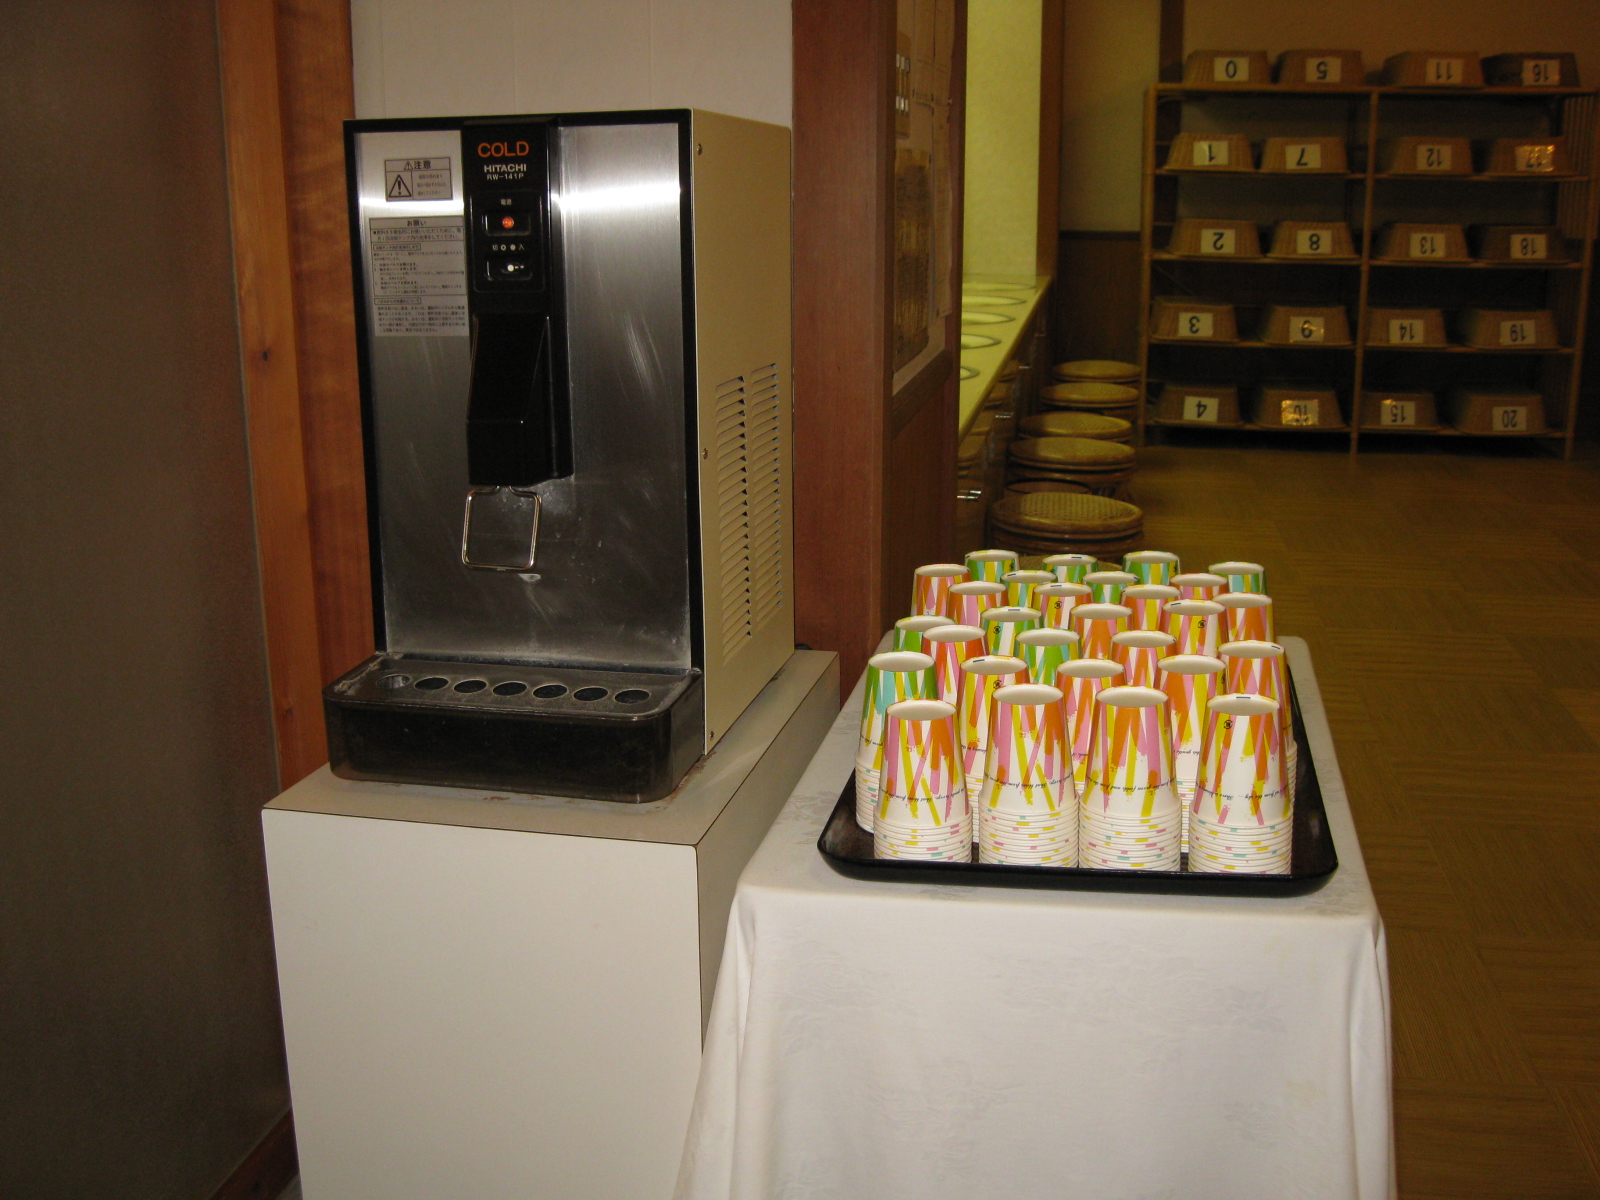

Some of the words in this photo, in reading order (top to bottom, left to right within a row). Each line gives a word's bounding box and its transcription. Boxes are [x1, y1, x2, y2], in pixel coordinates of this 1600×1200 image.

[1225, 60, 1236, 79] 0
[1317, 61, 1329, 79] 5
[1437, 63, 1453, 79] 11
[1531, 63, 1550, 81] 16
[478, 141, 530, 158] COLD
[1208, 144, 1216, 162] 1
[1296, 148, 1309, 166] 7
[1426, 148, 1443, 167] 12
[414, 160, 432, 170] 注意
[483, 163, 527, 173] HITACHI
[486, 173, 524, 181] RW-141P
[407, 219, 427, 227] お願い
[1213, 233, 1225, 250] 2
[1308, 233, 1320, 251] 8
[1420, 236, 1435, 254] 13
[1521, 238, 1537, 256] 18
[1188, 316, 1200, 334] 3
[1300, 321, 1313, 338] 9
[1399, 323, 1414, 339] 14
[1510, 324, 1527, 341] 19
[1196, 400, 1208, 419] 4
[1390, 404, 1405, 422] 15
[1502, 410, 1518, 426] 20
